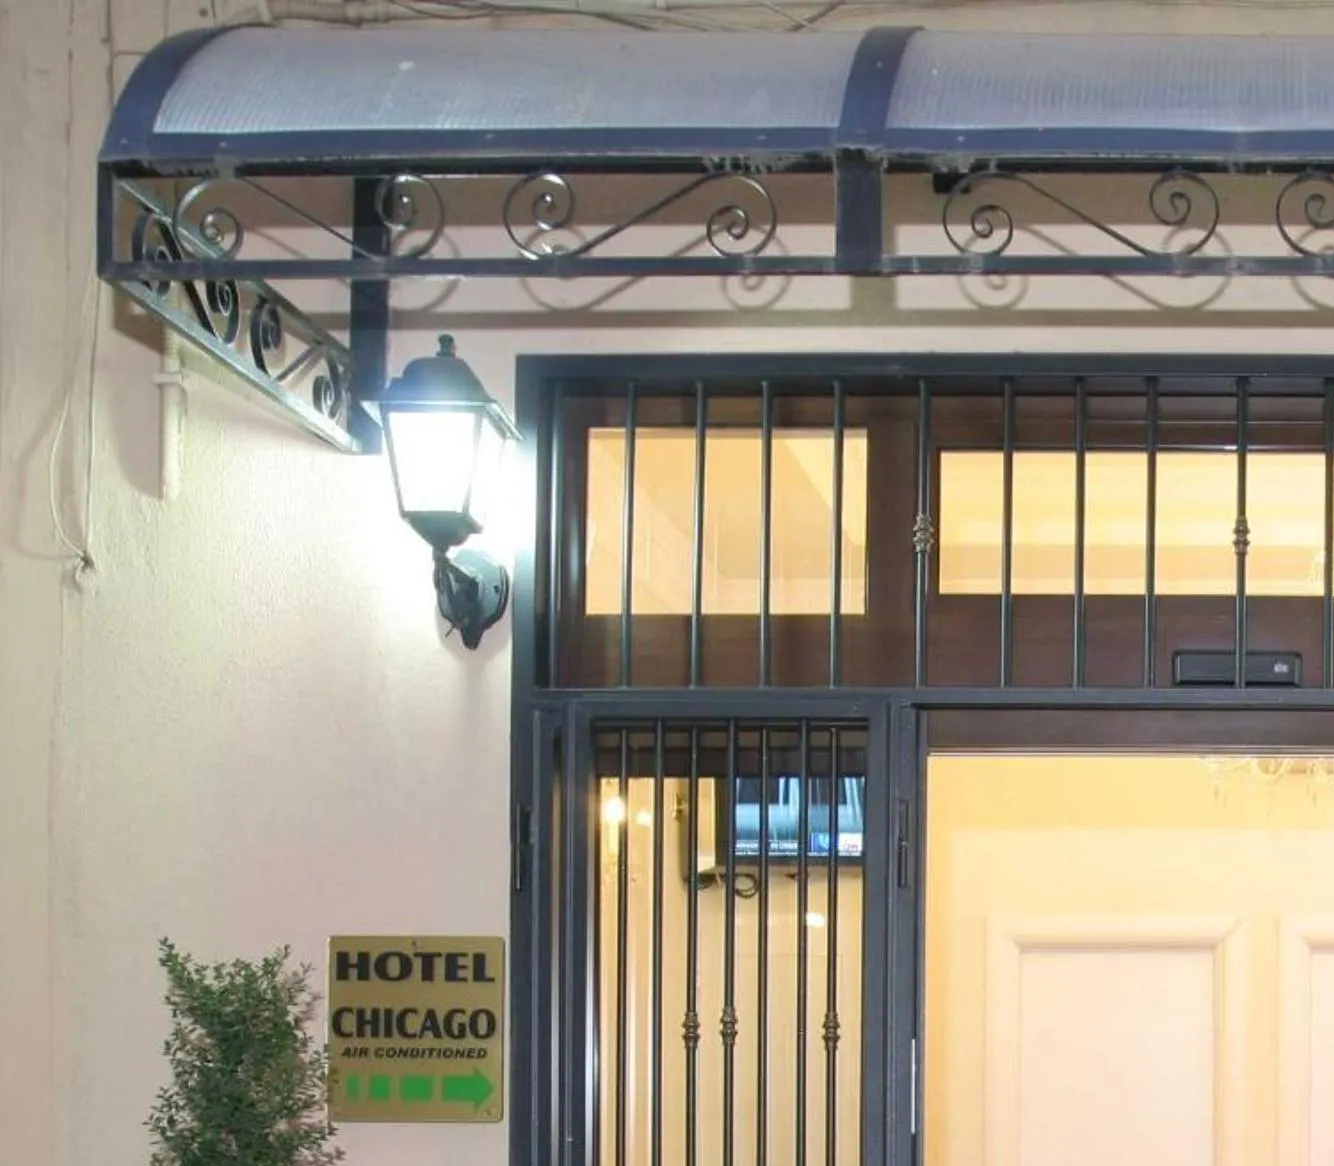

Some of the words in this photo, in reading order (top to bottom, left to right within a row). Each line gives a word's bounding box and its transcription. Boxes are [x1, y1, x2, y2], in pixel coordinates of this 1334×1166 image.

[336, 951, 495, 982] HOTEL
[332, 1006, 496, 1039] CHICAGO
[341, 1047, 368, 1059] AIR
[374, 1047, 488, 1060] CONDITIONED
